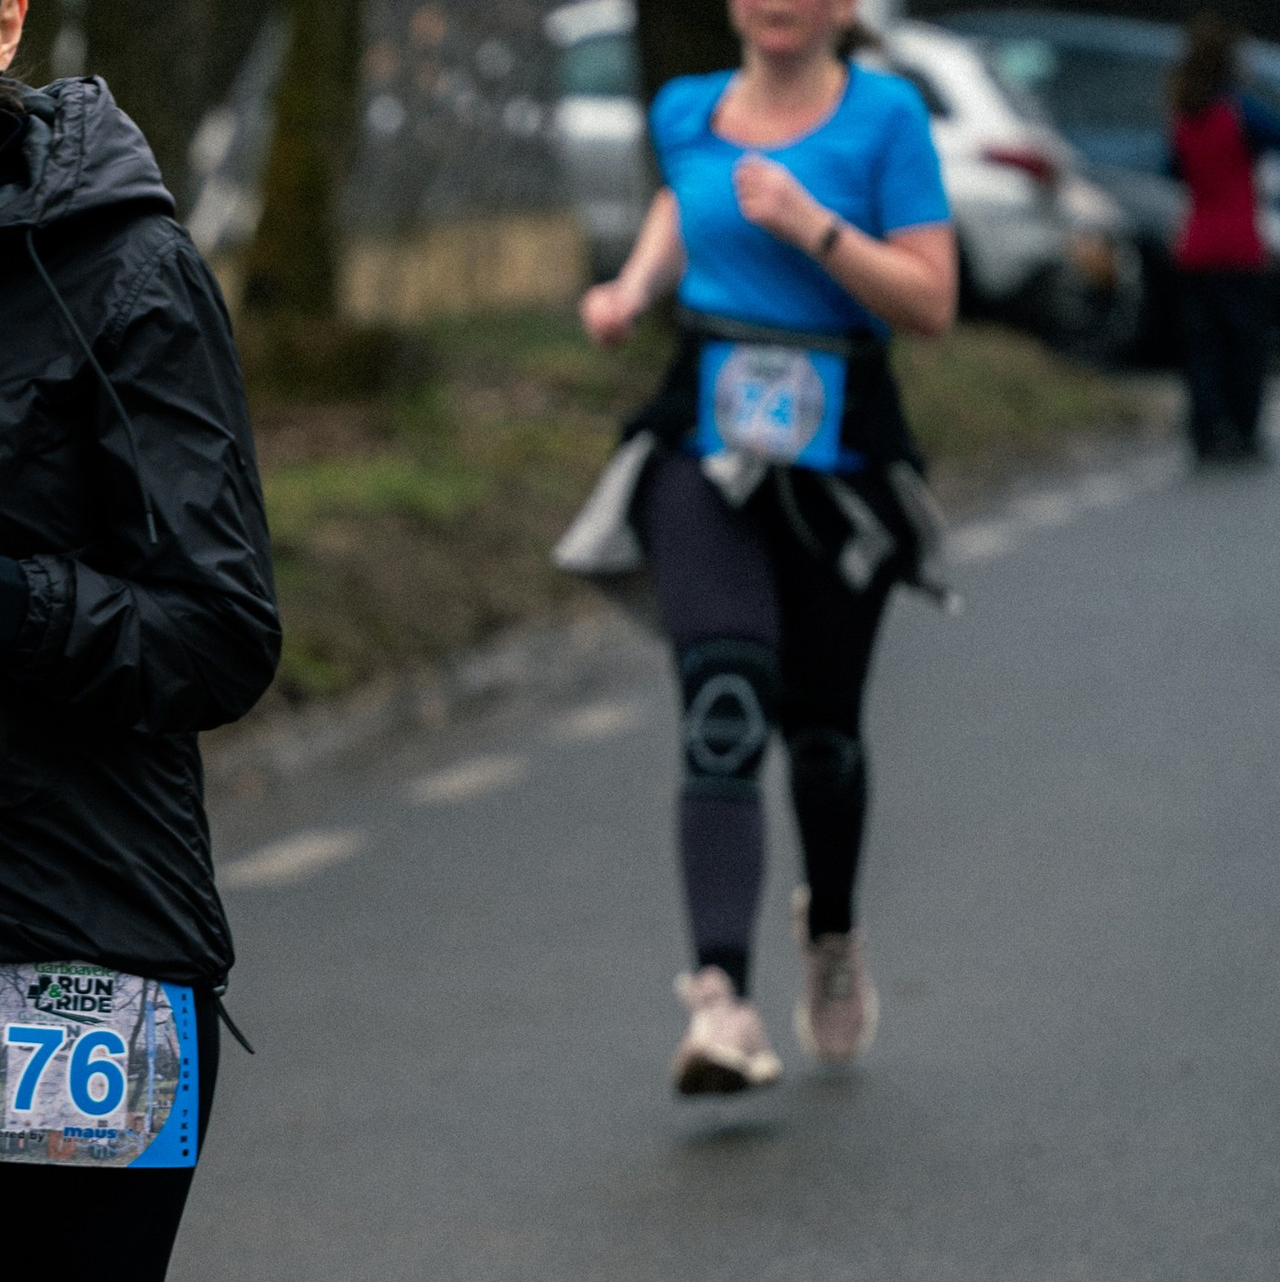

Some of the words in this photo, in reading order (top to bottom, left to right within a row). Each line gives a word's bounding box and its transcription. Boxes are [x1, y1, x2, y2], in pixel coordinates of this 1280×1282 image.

[48, 983, 62, 999] &
[58, 976, 114, 996] RUN
[56, 996, 113, 1014] RIDE
[6, 1024, 127, 1116] 76
[29, 1130, 46, 1143] by
[63, 1126, 117, 1140] maus
